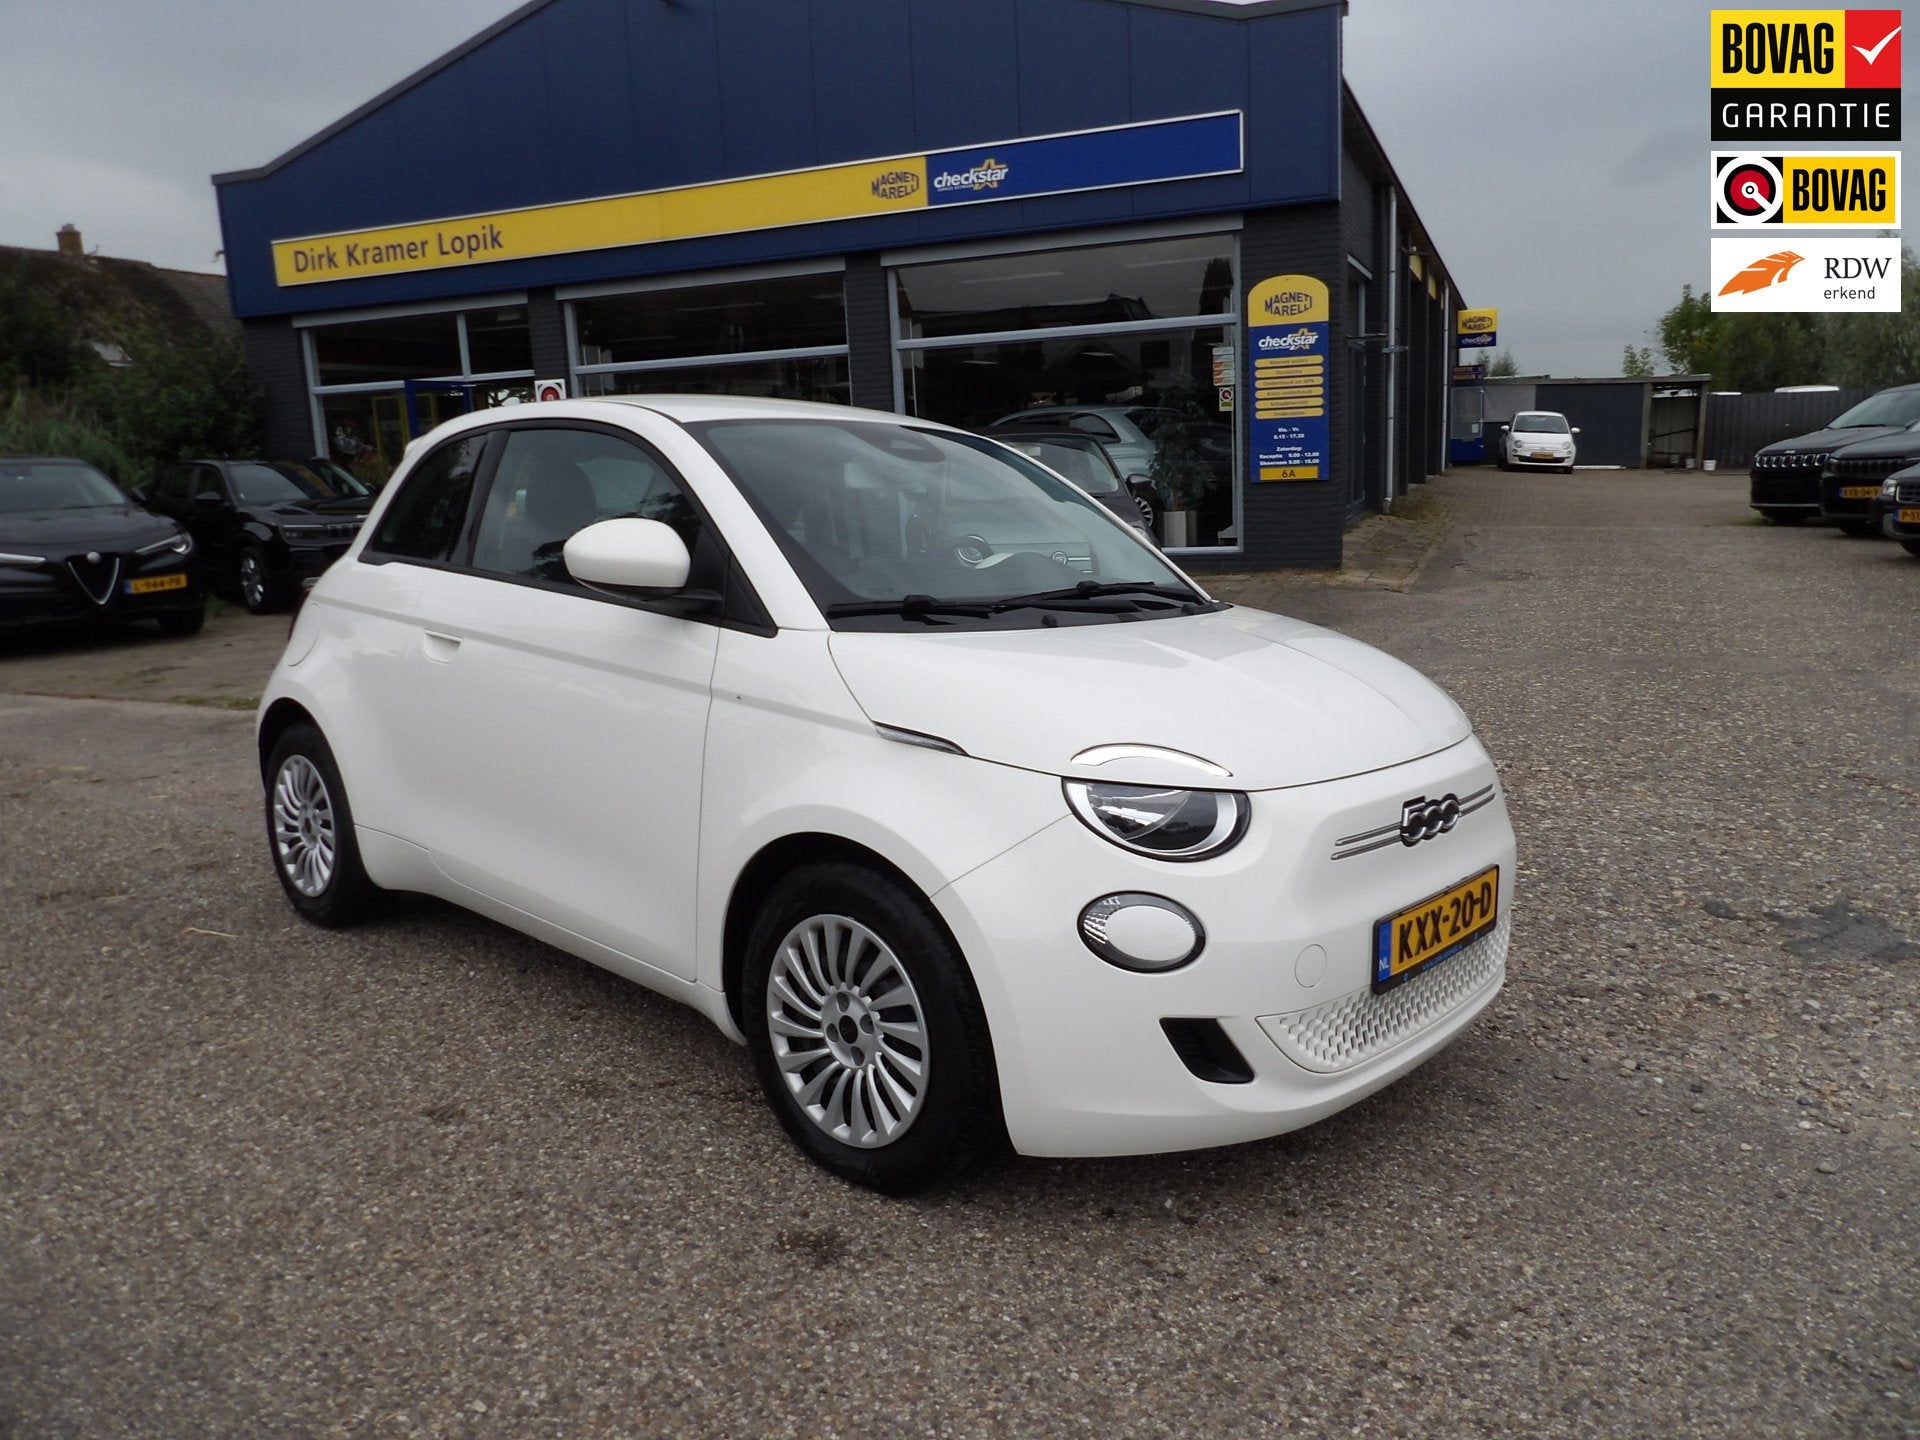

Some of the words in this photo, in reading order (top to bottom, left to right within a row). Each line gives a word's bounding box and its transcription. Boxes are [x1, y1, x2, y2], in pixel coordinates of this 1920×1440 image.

[872, 171, 920, 190] MAGNETI
[933, 167, 1009, 189] checkstar
[872, 179, 920, 199] MARELLI
[294, 245, 339, 273] Dirk
[346, 239, 429, 268] Kramer
[437, 223, 504, 259] Lopik
[1265, 291, 1313, 309] MAGNETI
[1265, 297, 1313, 317] MARELLI
[1258, 334, 1319, 348] checkstar
[1281, 469, 1296, 478] 6A
[1400, 793, 1461, 847] 500
[1379, 956, 1389, 971] NL
[1398, 880, 1492, 964] KXX-20-D
